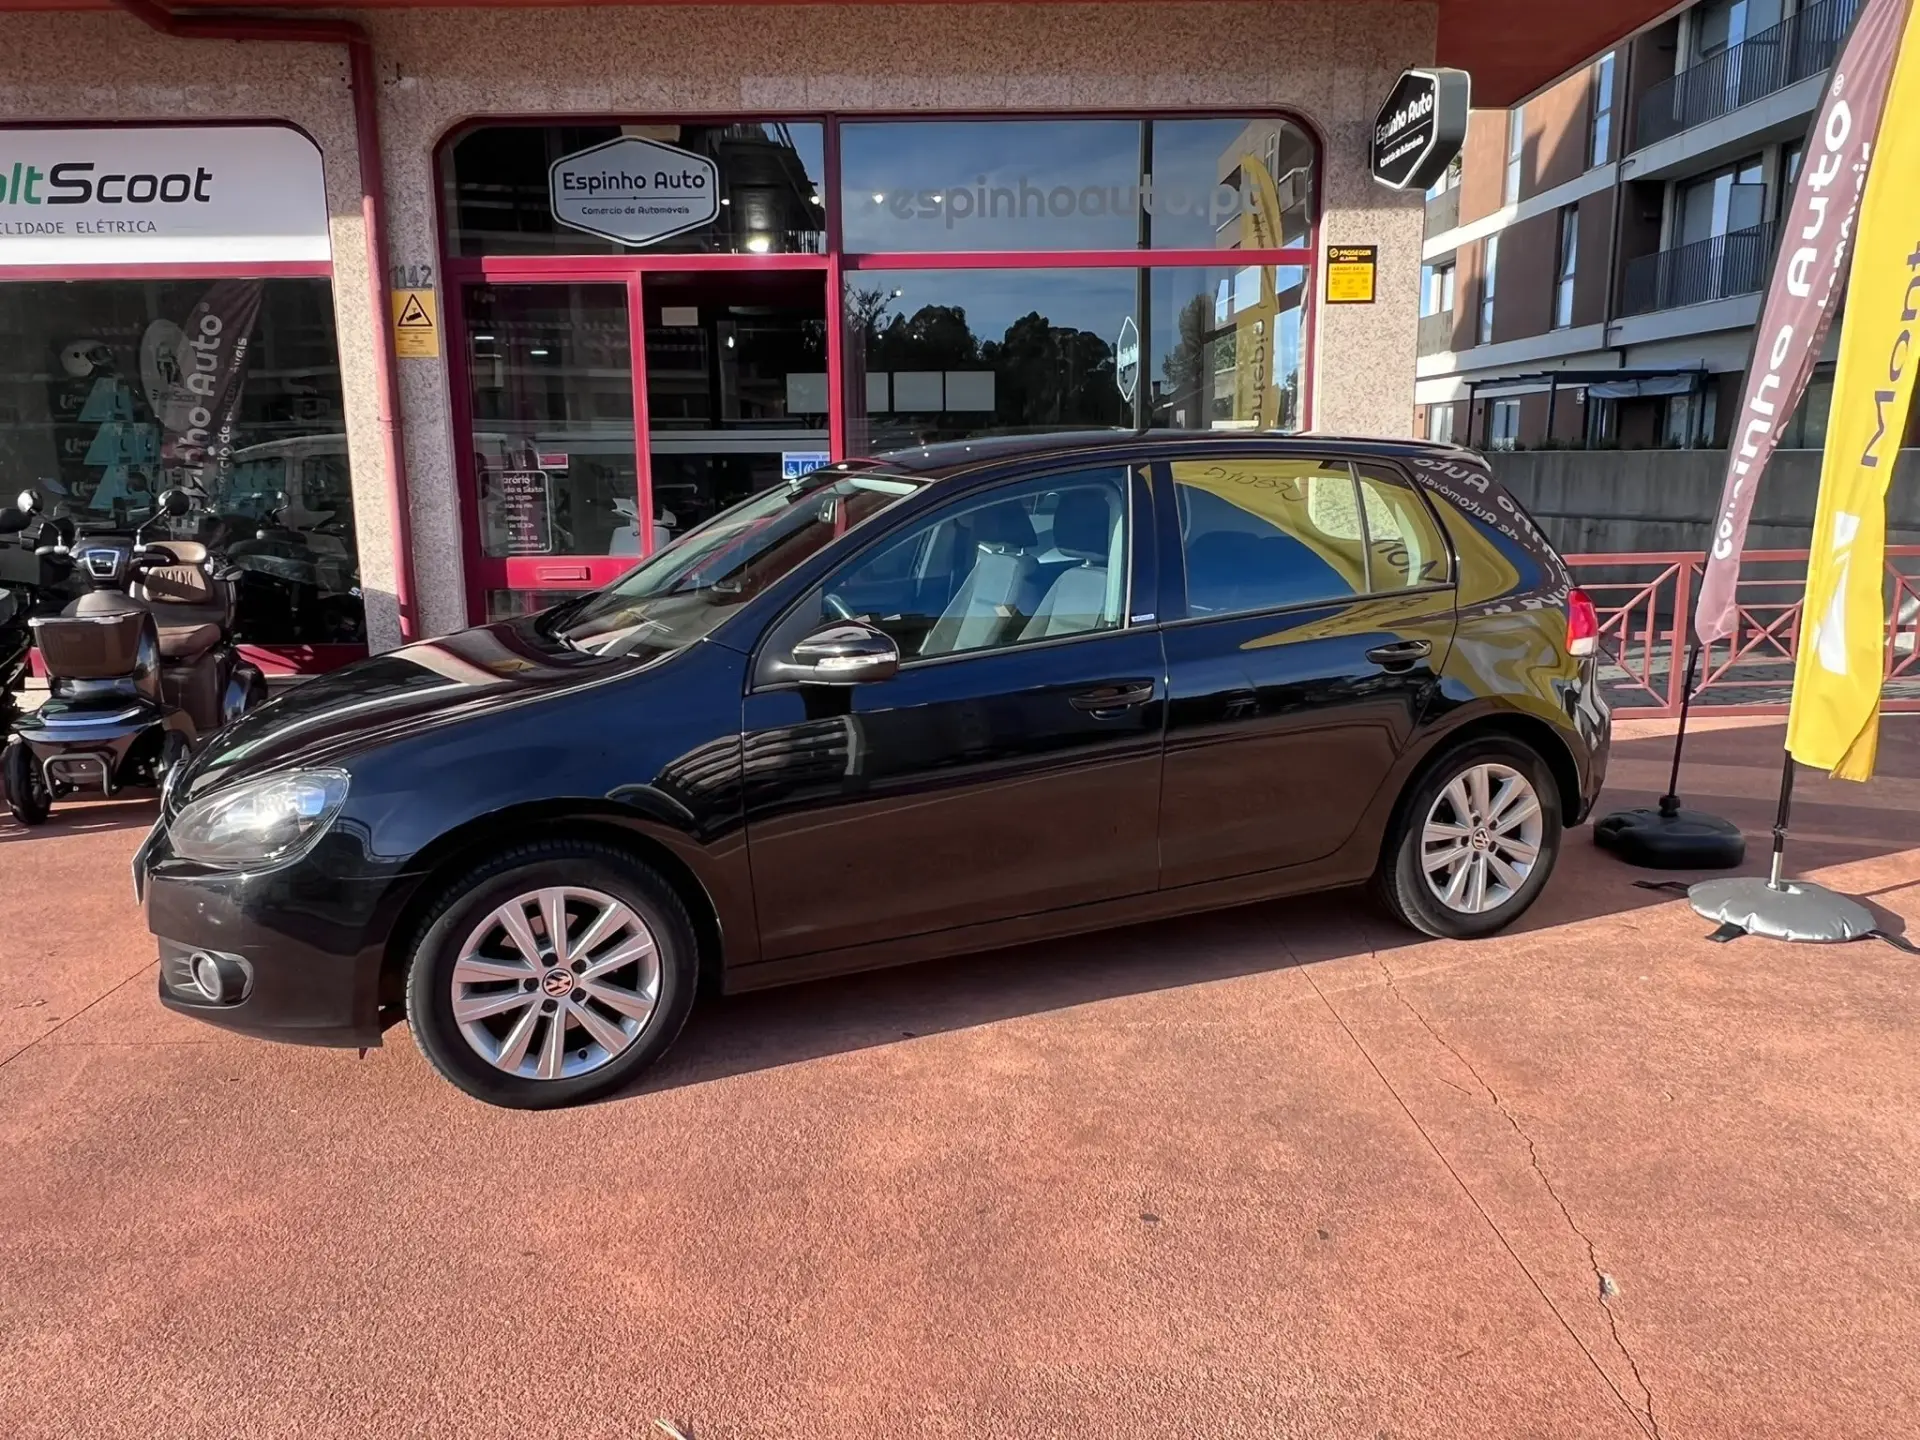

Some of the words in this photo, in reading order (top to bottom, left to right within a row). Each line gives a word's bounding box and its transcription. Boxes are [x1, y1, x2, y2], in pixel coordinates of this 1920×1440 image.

[1375, 110, 1407, 145] Espinho
[1407, 92, 1433, 123] Auto
[562, 171, 647, 195] Espinho
[654, 170, 706, 190] Auto
[1786, 99, 1852, 297] Auto
[76, 219, 158, 235] ELÉTRICA
[624, 205, 636, 215] de
[186, 314, 224, 397] Auto
